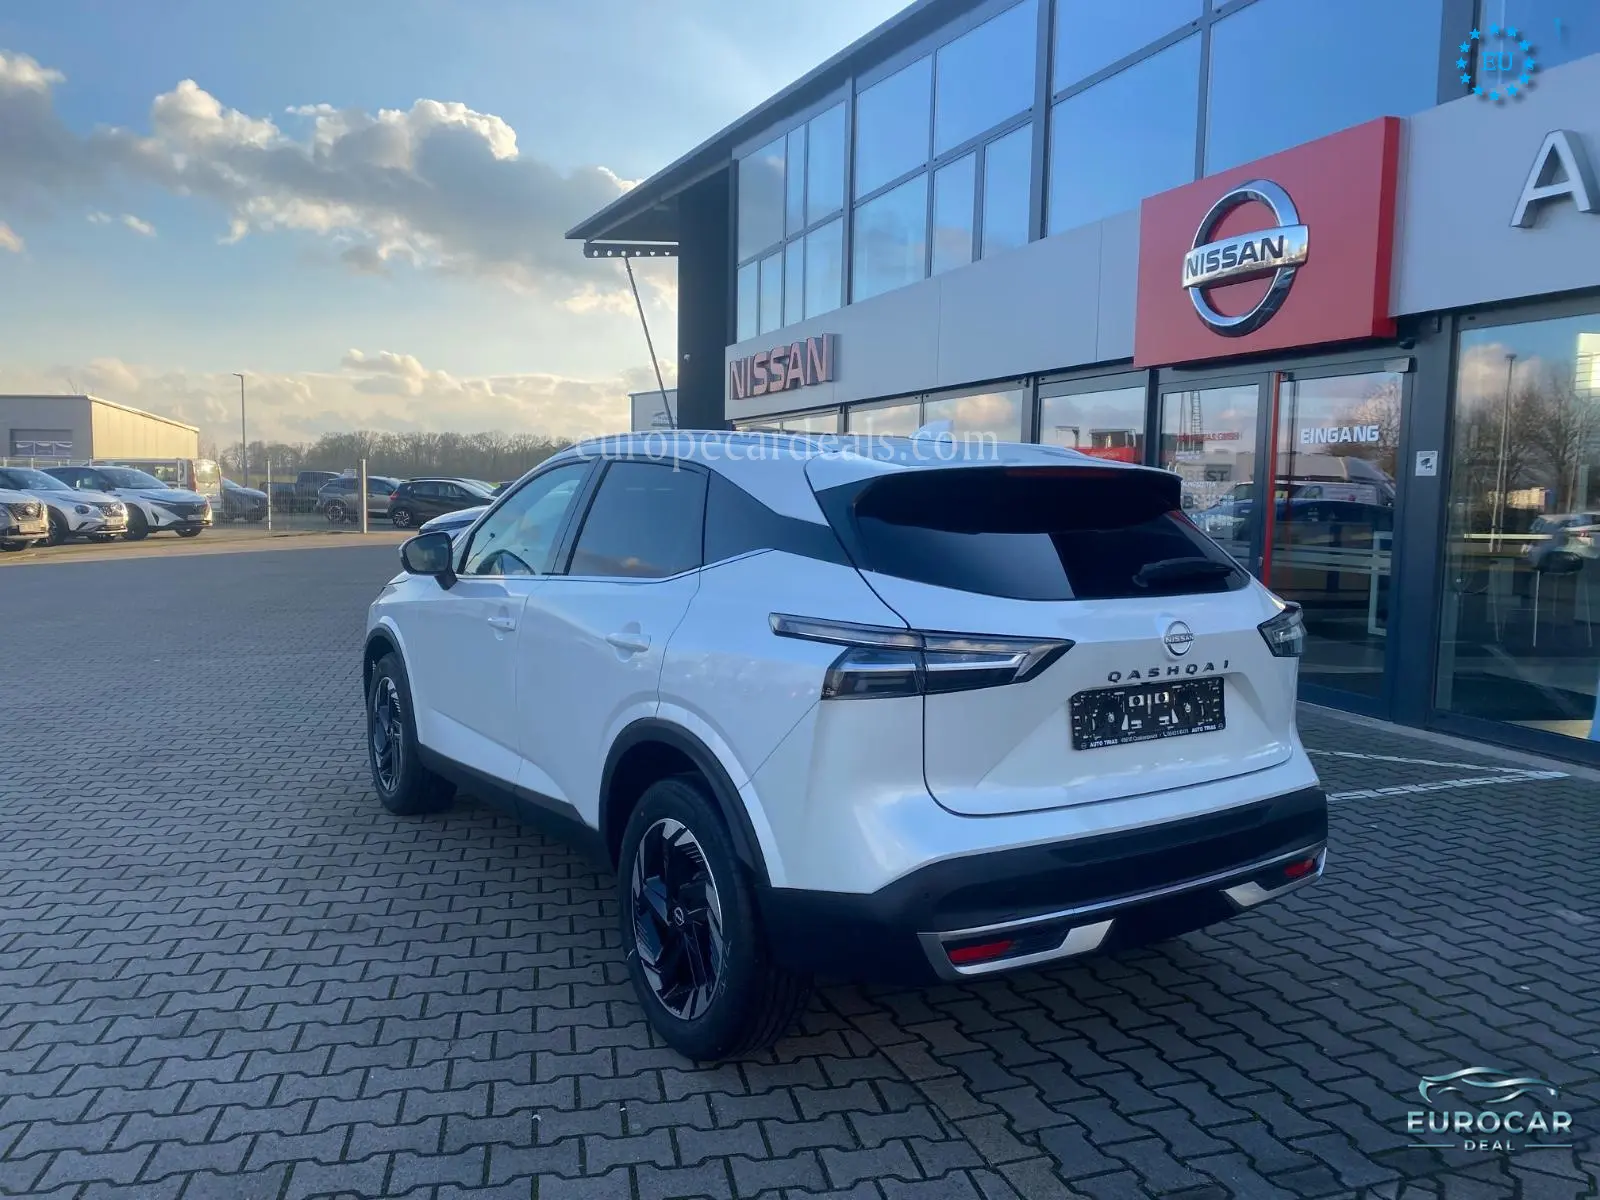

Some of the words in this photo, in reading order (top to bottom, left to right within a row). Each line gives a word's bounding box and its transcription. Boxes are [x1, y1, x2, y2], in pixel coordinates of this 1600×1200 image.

[1185, 234, 1285, 279] NISSAN
[729, 333, 836, 400] NISSAN
[1300, 424, 1380, 444] EINGANG
[1165, 633, 1194, 643] NISSAN
[1107, 659, 1230, 683] QASHQAI
